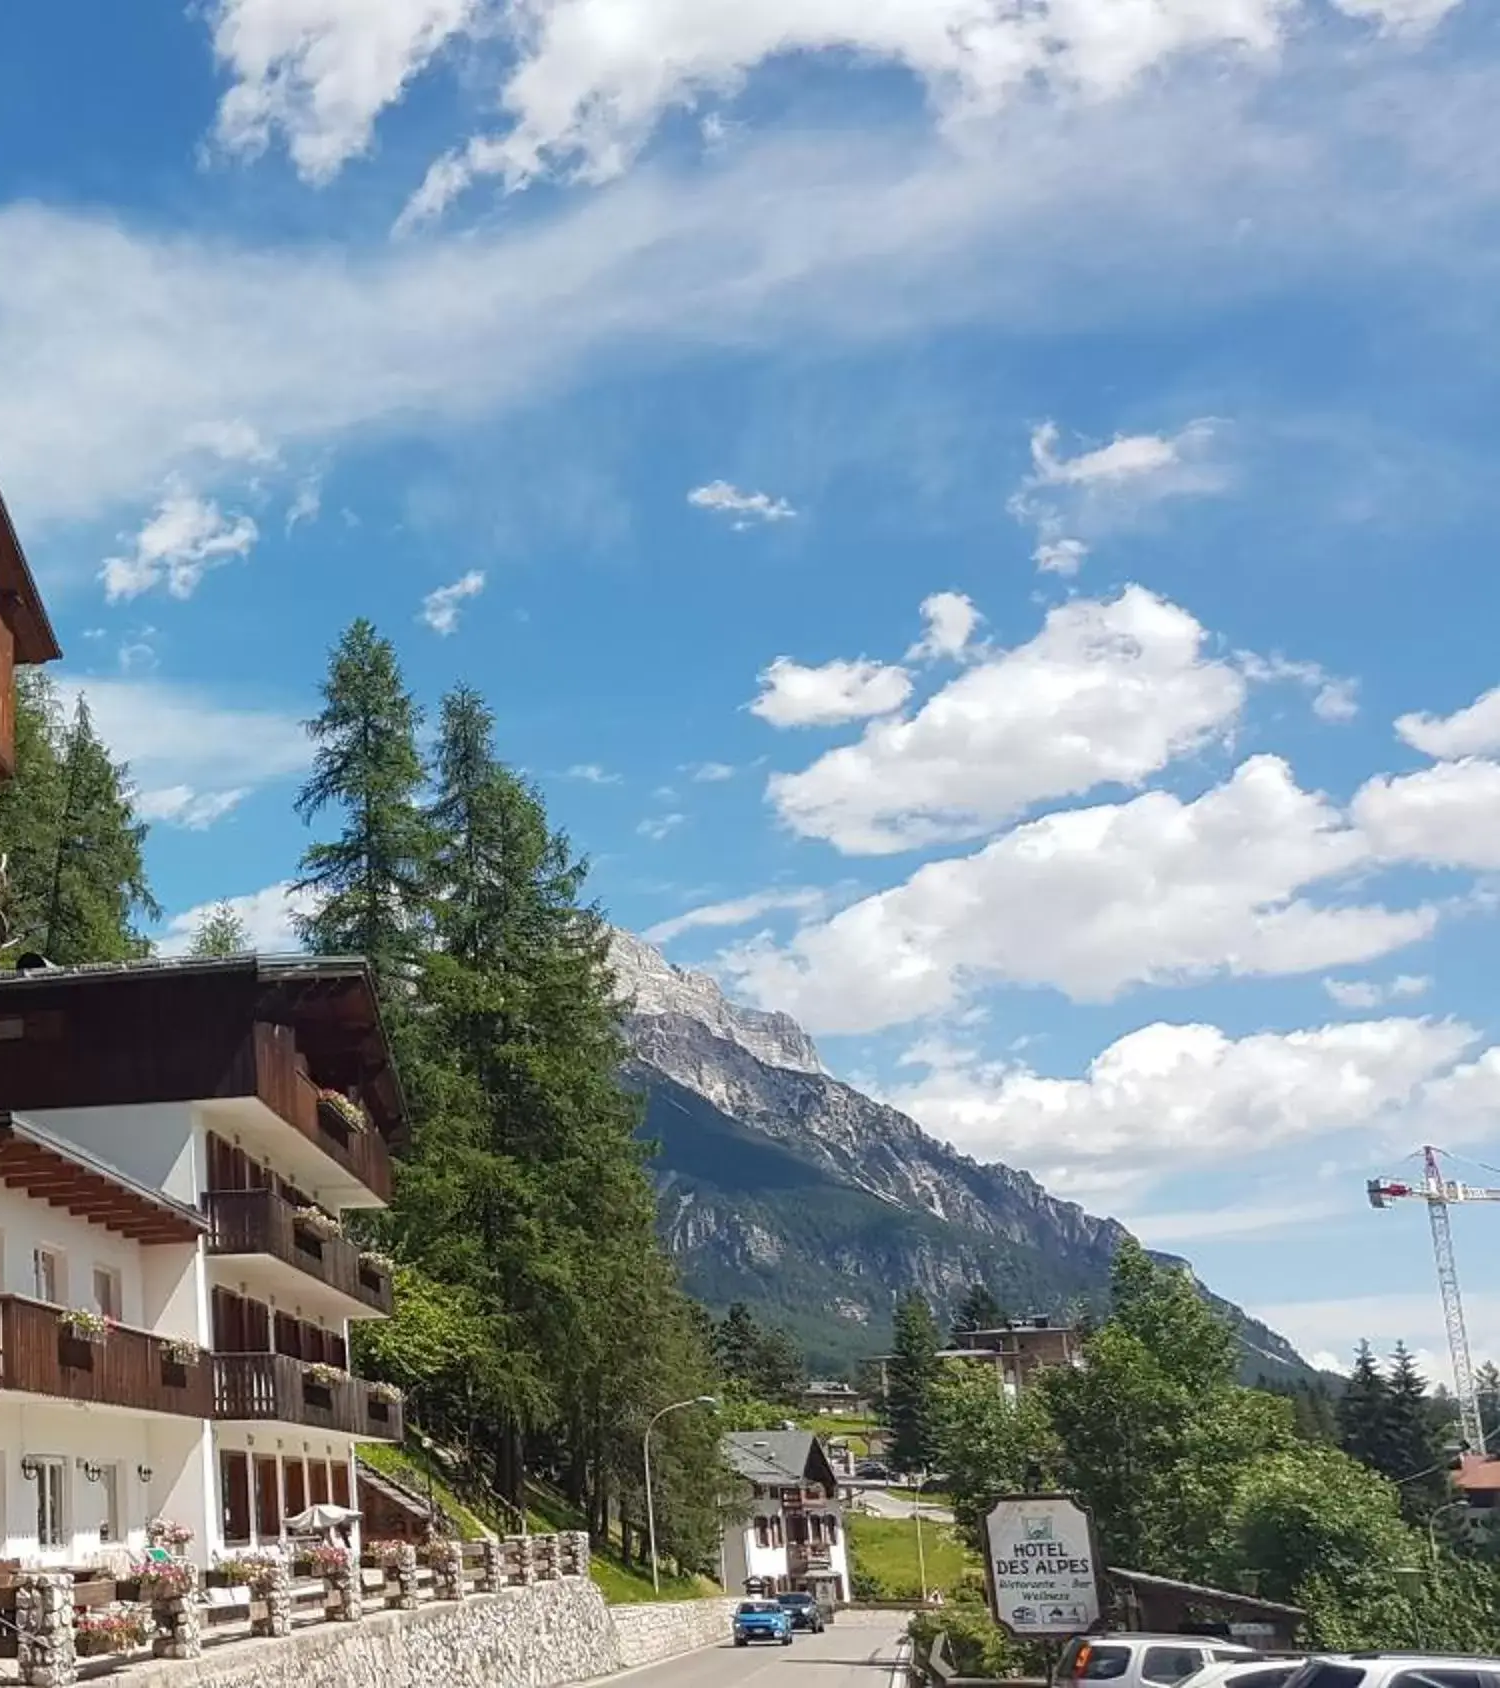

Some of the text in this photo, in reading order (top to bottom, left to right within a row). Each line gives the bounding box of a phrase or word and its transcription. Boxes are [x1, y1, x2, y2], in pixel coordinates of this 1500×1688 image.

[1013, 1543, 1068, 1557] HOTEL
[996, 1558, 1089, 1574] DES ALPES
[999, 1579, 1056, 1588] Ristorante
[1021, 1590, 1071, 1601] Wellness
